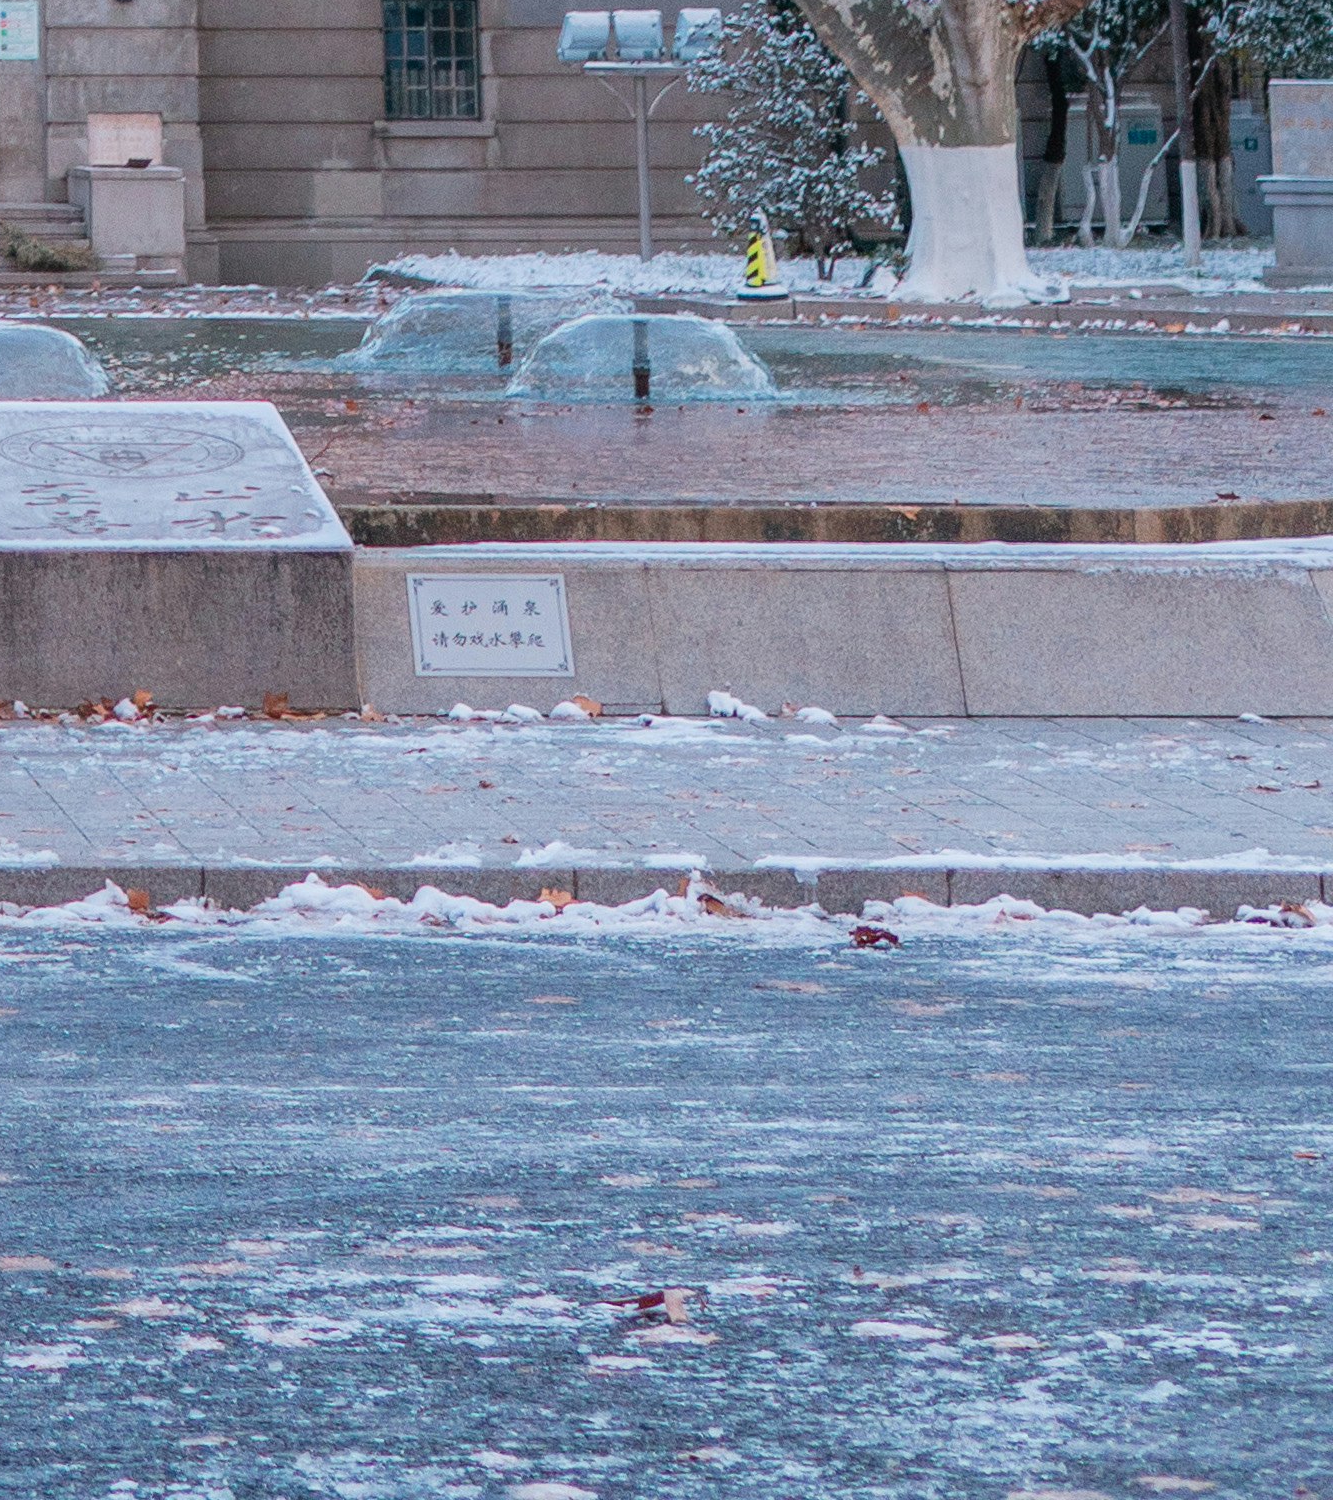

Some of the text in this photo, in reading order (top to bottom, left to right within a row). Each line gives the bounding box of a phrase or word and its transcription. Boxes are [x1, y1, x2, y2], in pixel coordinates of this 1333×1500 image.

[430, 600, 541, 617] 爱护涌泉
[432, 632, 546, 649] 请勿戏水攀爬
